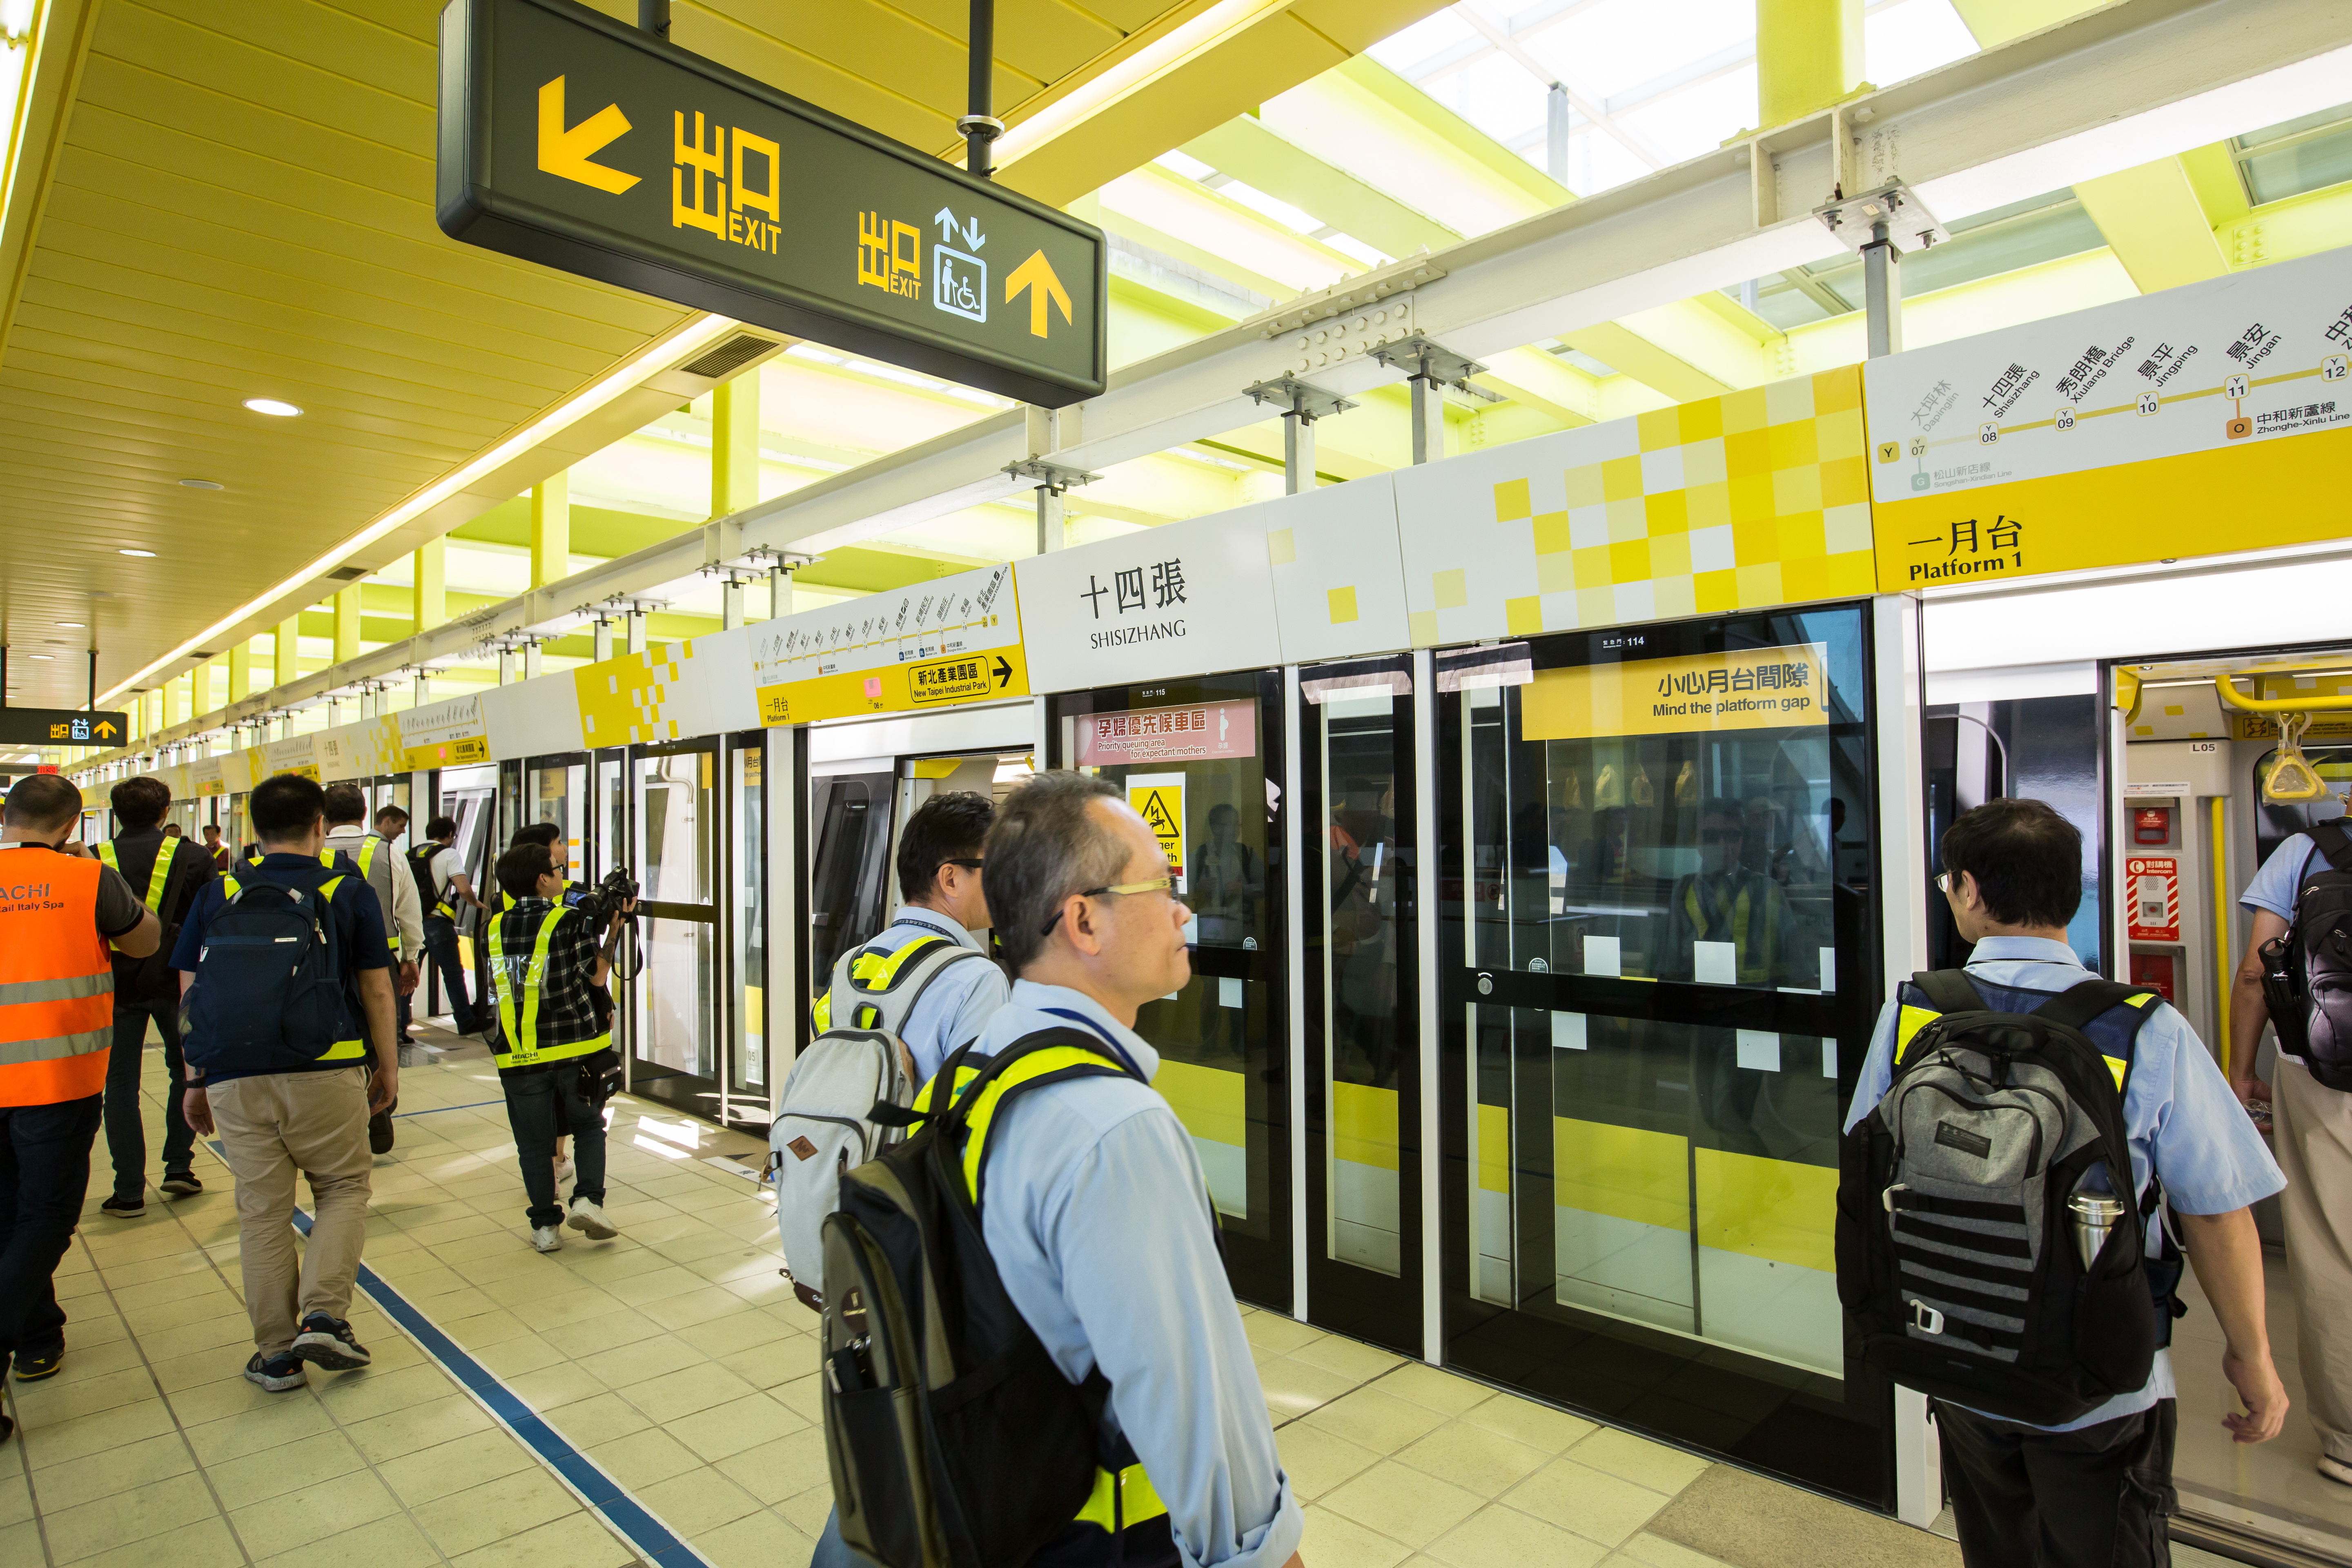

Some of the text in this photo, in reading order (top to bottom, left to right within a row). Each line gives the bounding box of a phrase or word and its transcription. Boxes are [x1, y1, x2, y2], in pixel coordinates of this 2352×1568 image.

[673, 111, 780, 240] 出口
[729, 210, 781, 254] EXIT
[858, 211, 920, 292] 出口
[890, 273, 921, 300] EXIT
[2226, 323, 2271, 362] 景安
[2246, 334, 2282, 369] Jingan
[2055, 345, 2107, 397] 秀朗橋
[2070, 336, 2135, 404] Xiulang Bridge
[2137, 343, 2174, 380] 景平
[2156, 345, 2198, 388] Jingping
[2325, 366, 2345, 378] 12
[1982, 363, 2027, 410] 十四張
[1994, 370, 2040, 418] Shisizhang
[2229, 385, 2245, 397] 11
[1911, 380, 1951, 426] 大坪林
[1922, 391, 1959, 432] Dapinglin
[2140, 402, 2157, 414] 10
[2257, 401, 2336, 425] 中和新蘆線
[2058, 418, 2073, 429] 09
[2234, 423, 2245, 433] O
[2257, 412, 2350, 434] Zhonghe-Xinlu Line
[1982, 432, 1997, 443] 08
[1884, 448, 1892, 458] Y
[1911, 445, 1925, 456] 07
[1917, 478, 1924, 486] G
[1933, 462, 1991, 480] 松山新店線
[1934, 470, 2012, 488] Songshan-Xindian Line
[1908, 515, 2022, 556] 一月台
[1910, 551, 2021, 581] Platform 1
[1080, 558, 1187, 619] 十四張
[1091, 619, 1186, 649] SHISIZHANG
[1628, 636, 1644, 646] 114
[918, 663, 978, 686] 新北產業園區
[1658, 662, 1809, 697] 小心月台間隙
[927, 686, 943, 697] Taipei
[945, 683, 971, 693] Industrial
[973, 681, 987, 690] Park
[766, 697, 788, 713] 一月台
[1653, 697, 1810, 716] Mind the platform gap
[767, 714, 786, 722] Platform
[1098, 710, 1206, 737] 孕婦優先候車區
[50, 724, 69, 738] 出口
[1098, 741, 1120, 751] Priority
[1123, 739, 1149, 751] queuing
[1142, 748, 1175, 759] expectant
[1177, 746, 1205, 755] mothers
[18, 902, 40, 911] Italy
[43, 901, 64, 909] Spa
